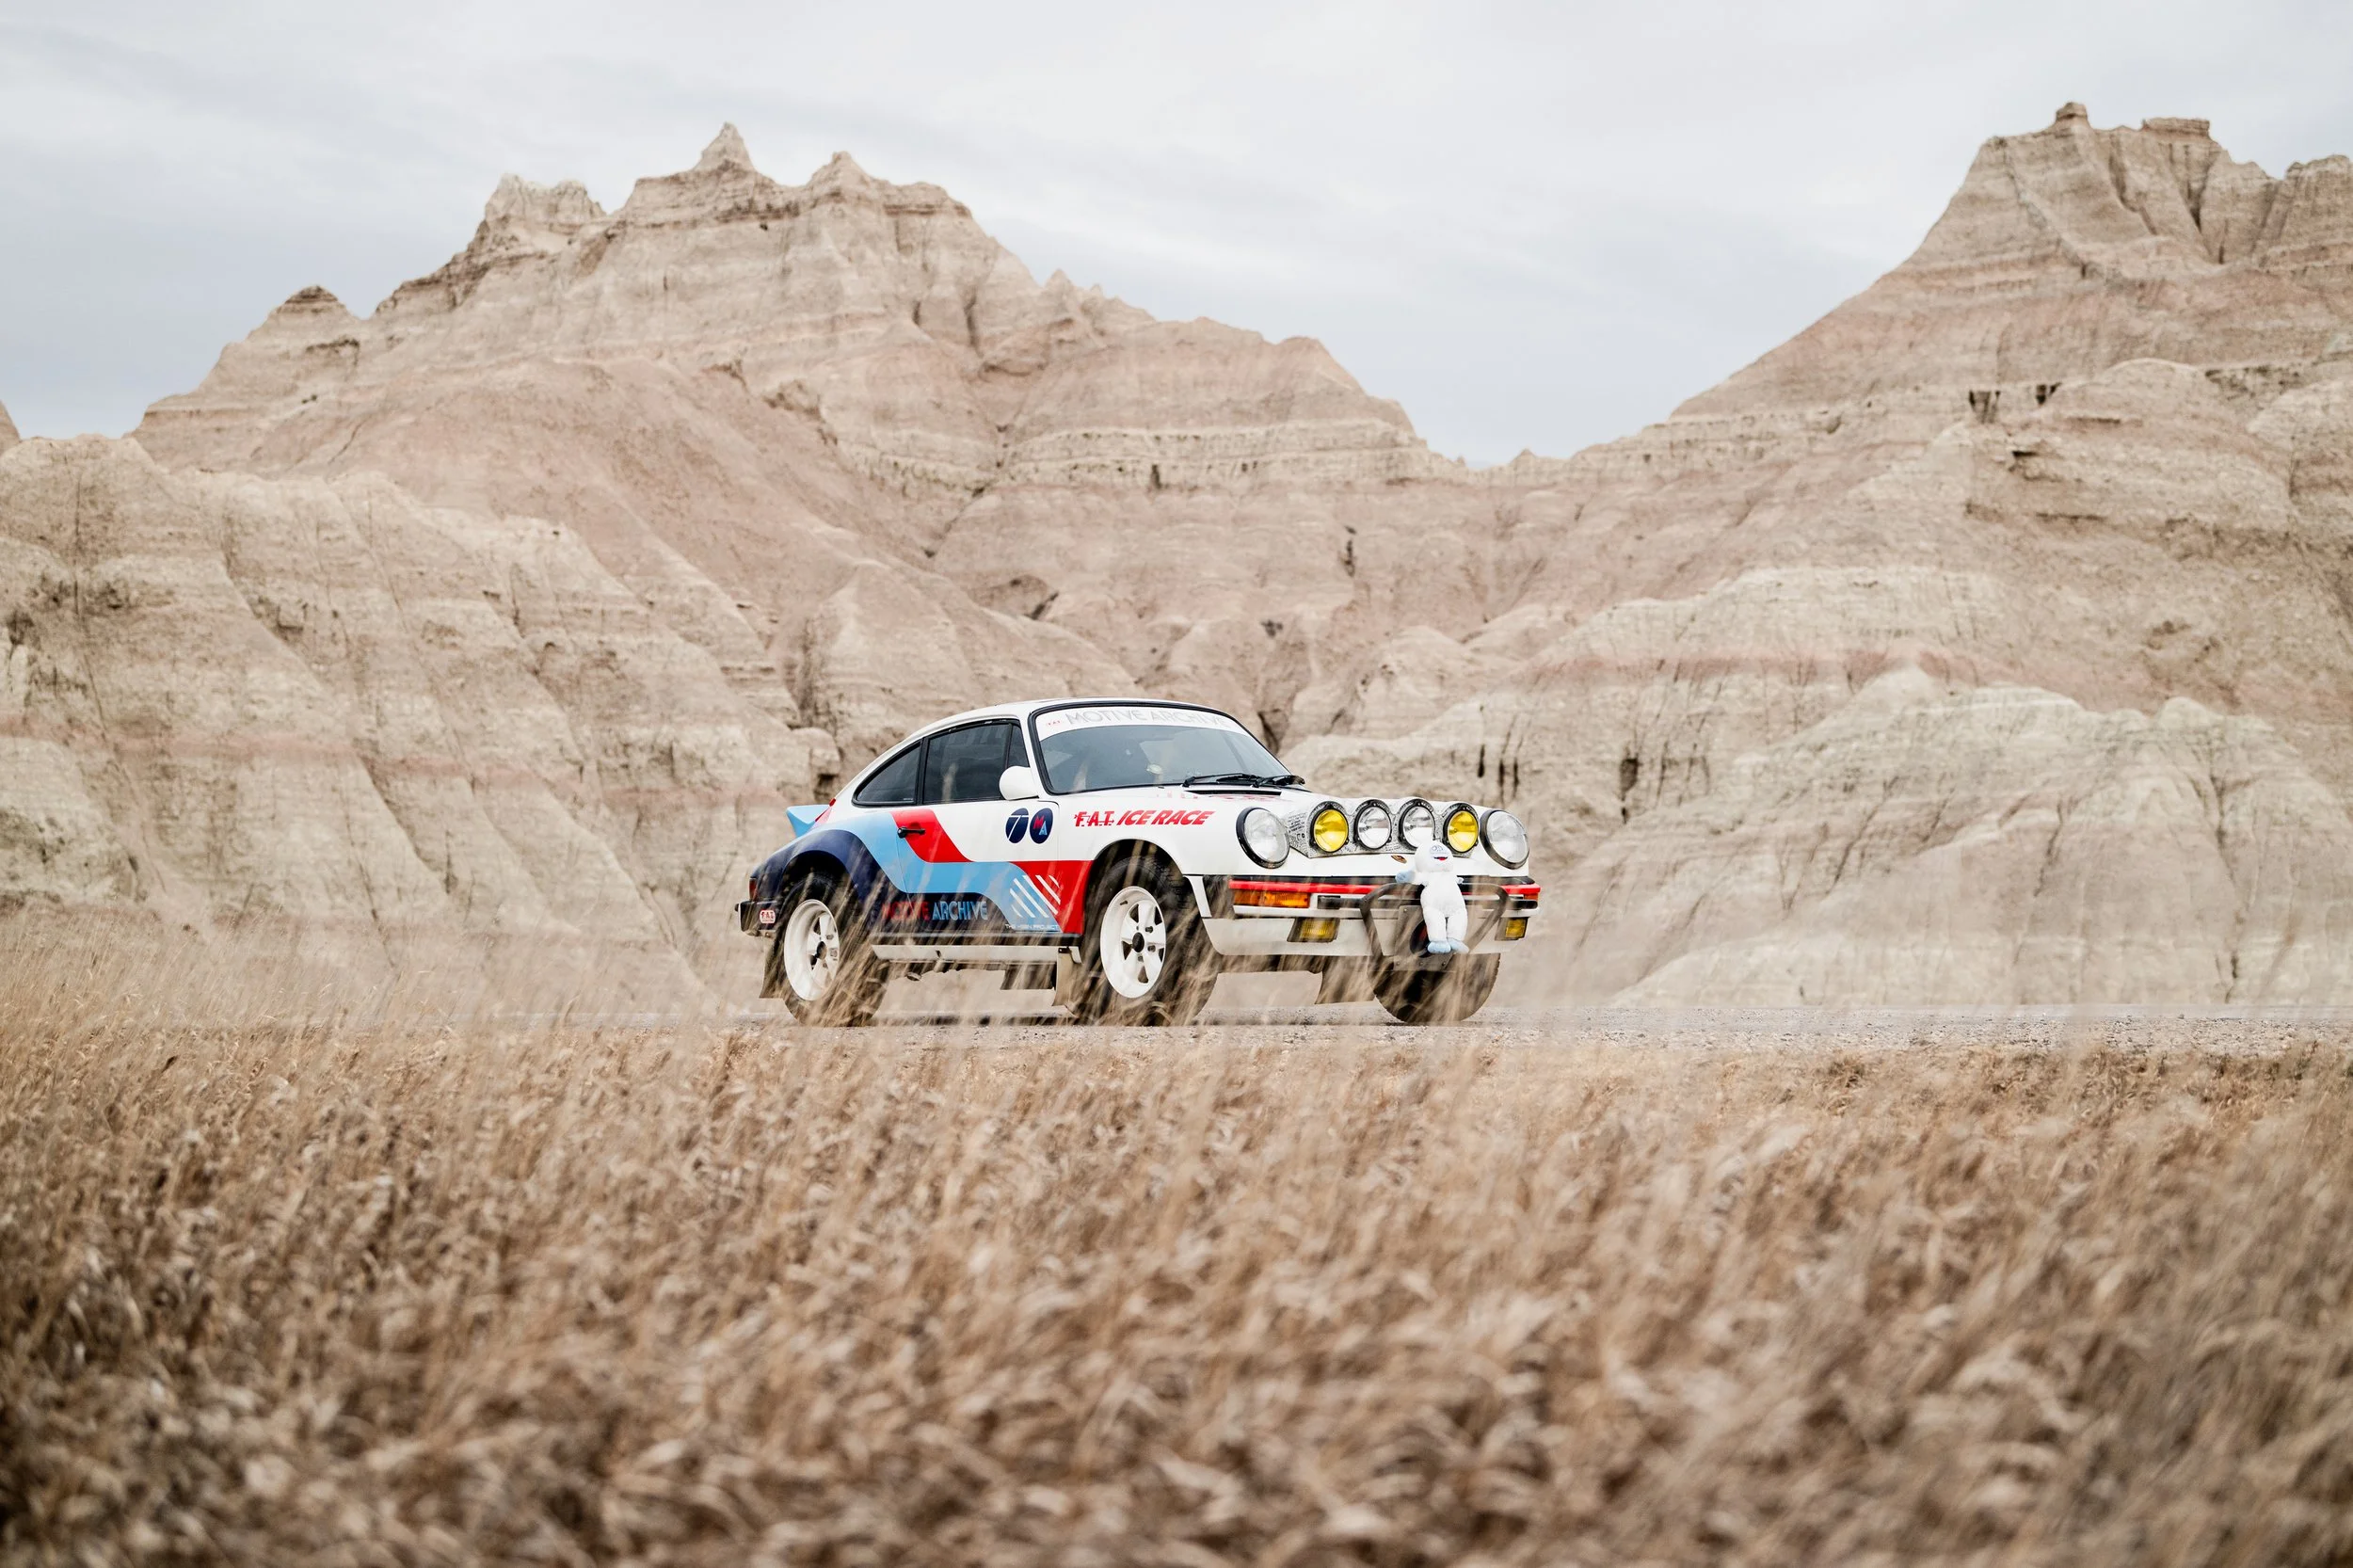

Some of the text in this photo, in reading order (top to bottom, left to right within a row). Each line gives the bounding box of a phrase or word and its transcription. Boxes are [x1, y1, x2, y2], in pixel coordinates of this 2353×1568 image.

[1064, 709, 1230, 728] MOTIVE ARCHIVE
[1116, 809, 1157, 825] ICE
[1150, 809, 1215, 825] RACE
[932, 901, 987, 920] ARCHIVE
